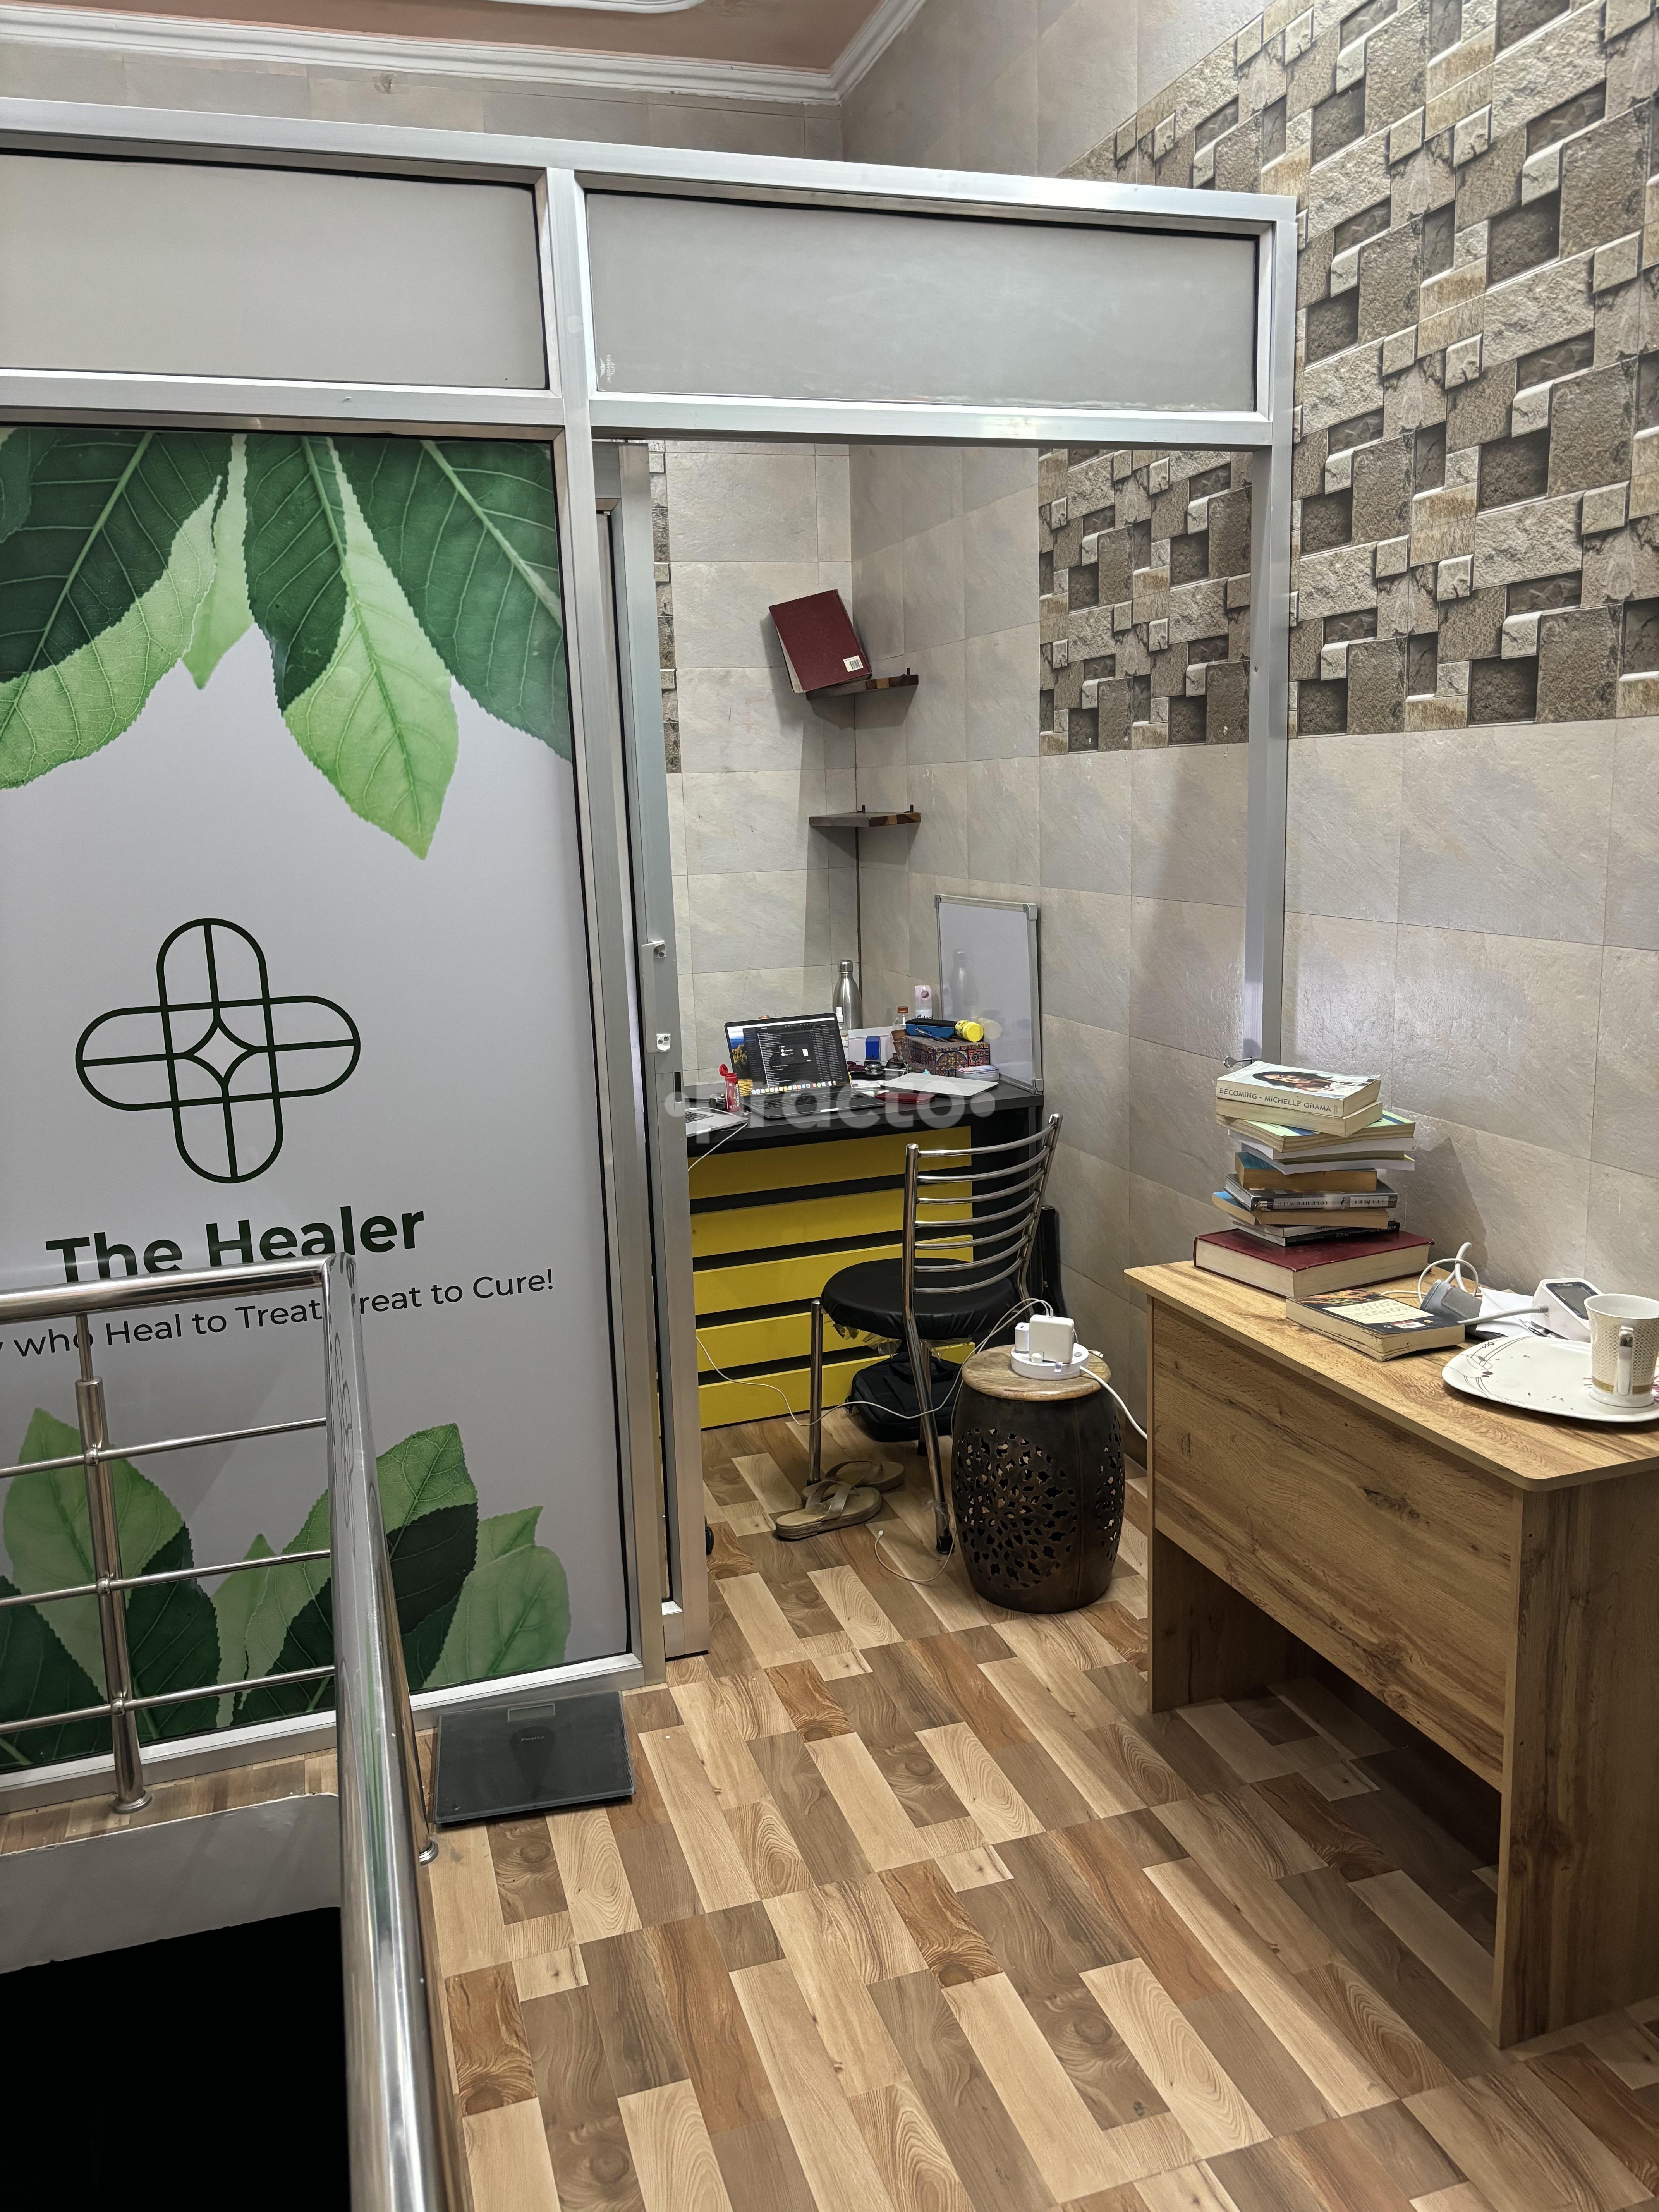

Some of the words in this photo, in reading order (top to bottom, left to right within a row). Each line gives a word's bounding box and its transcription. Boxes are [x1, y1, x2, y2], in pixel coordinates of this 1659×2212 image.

[1219, 1087, 1257, 1099] BECOMING
[1264, 1096, 1301, 1107] MICHELLE
[1304, 1103, 1331, 1112] OBAMA
[45, 1231, 183, 1283] The
[206, 1206, 424, 1267] Healer
[106, 1313, 182, 1345] Heal
[192, 1314, 227, 1335] to
[235, 1300, 323, 1329] Treat
[360, 1287, 422, 1314] reat
[430, 1284, 463, 1305] to
[473, 1268, 553, 1298] Cure!
